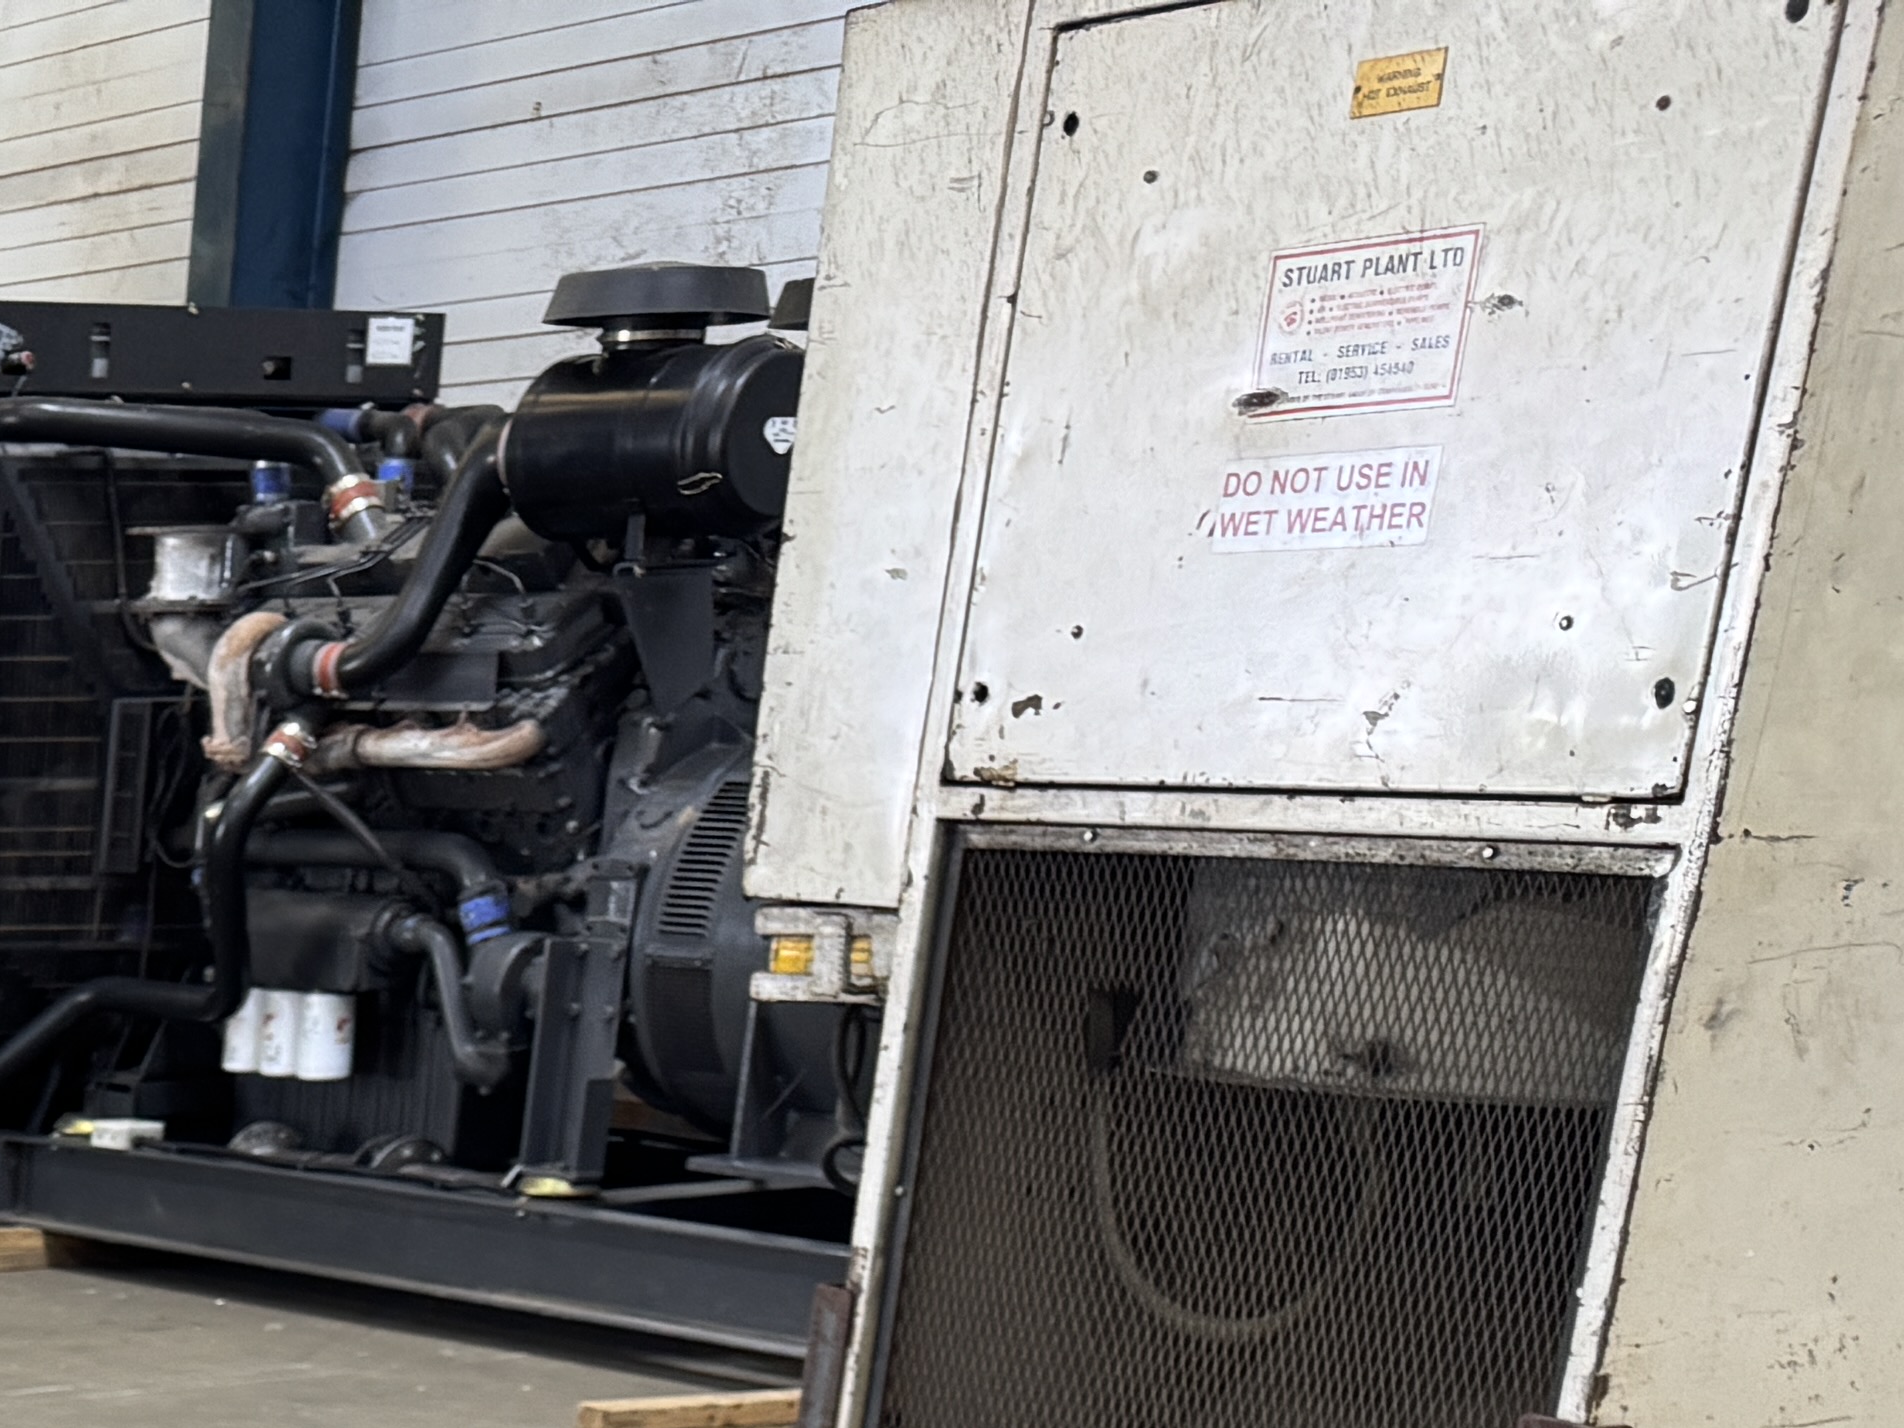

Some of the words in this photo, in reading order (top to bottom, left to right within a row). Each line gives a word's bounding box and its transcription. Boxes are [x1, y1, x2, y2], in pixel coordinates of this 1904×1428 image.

[1281, 259, 1356, 288] STUART
[1360, 251, 1423, 278] PLANT
[1428, 246, 1465, 271] LTD
[1269, 349, 1314, 367] RENTAL
[1336, 340, 1389, 359] SERVICE
[1410, 335, 1451, 351] SALES
[1222, 470, 1263, 498] DO
[1269, 466, 1329, 496] NOT
[1336, 462, 1393, 492] USE
[1399, 459, 1430, 489] IN
[1220, 510, 1279, 538] WET
[1286, 501, 1427, 535] WEATHER
